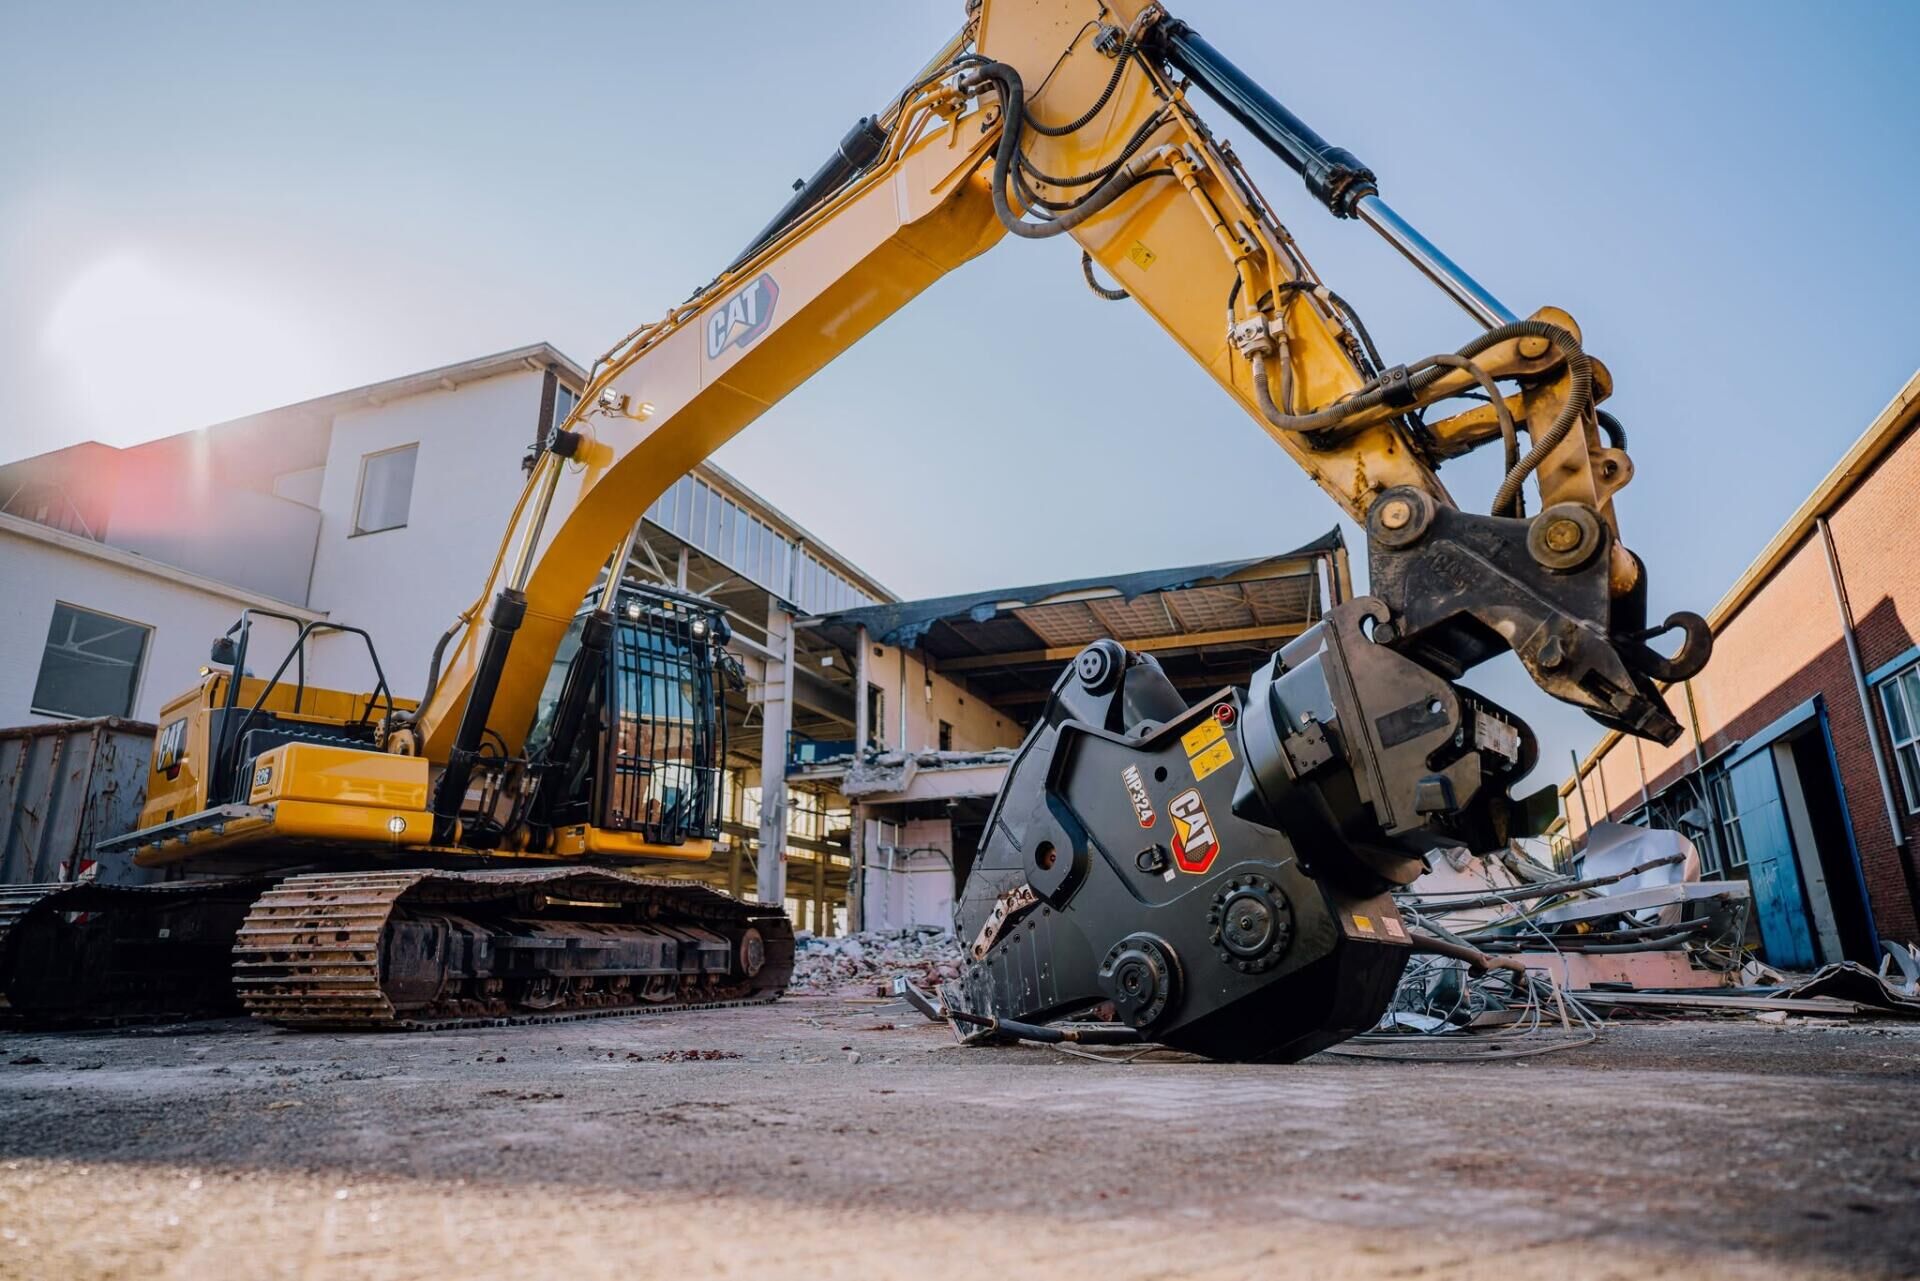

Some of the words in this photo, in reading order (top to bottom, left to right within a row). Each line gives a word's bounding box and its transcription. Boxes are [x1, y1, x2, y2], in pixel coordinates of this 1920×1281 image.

[708, 279, 761, 358] CAT
[157, 719, 187, 772] CAT
[1123, 765, 1154, 822] MP324
[1170, 790, 1216, 854] CAT
